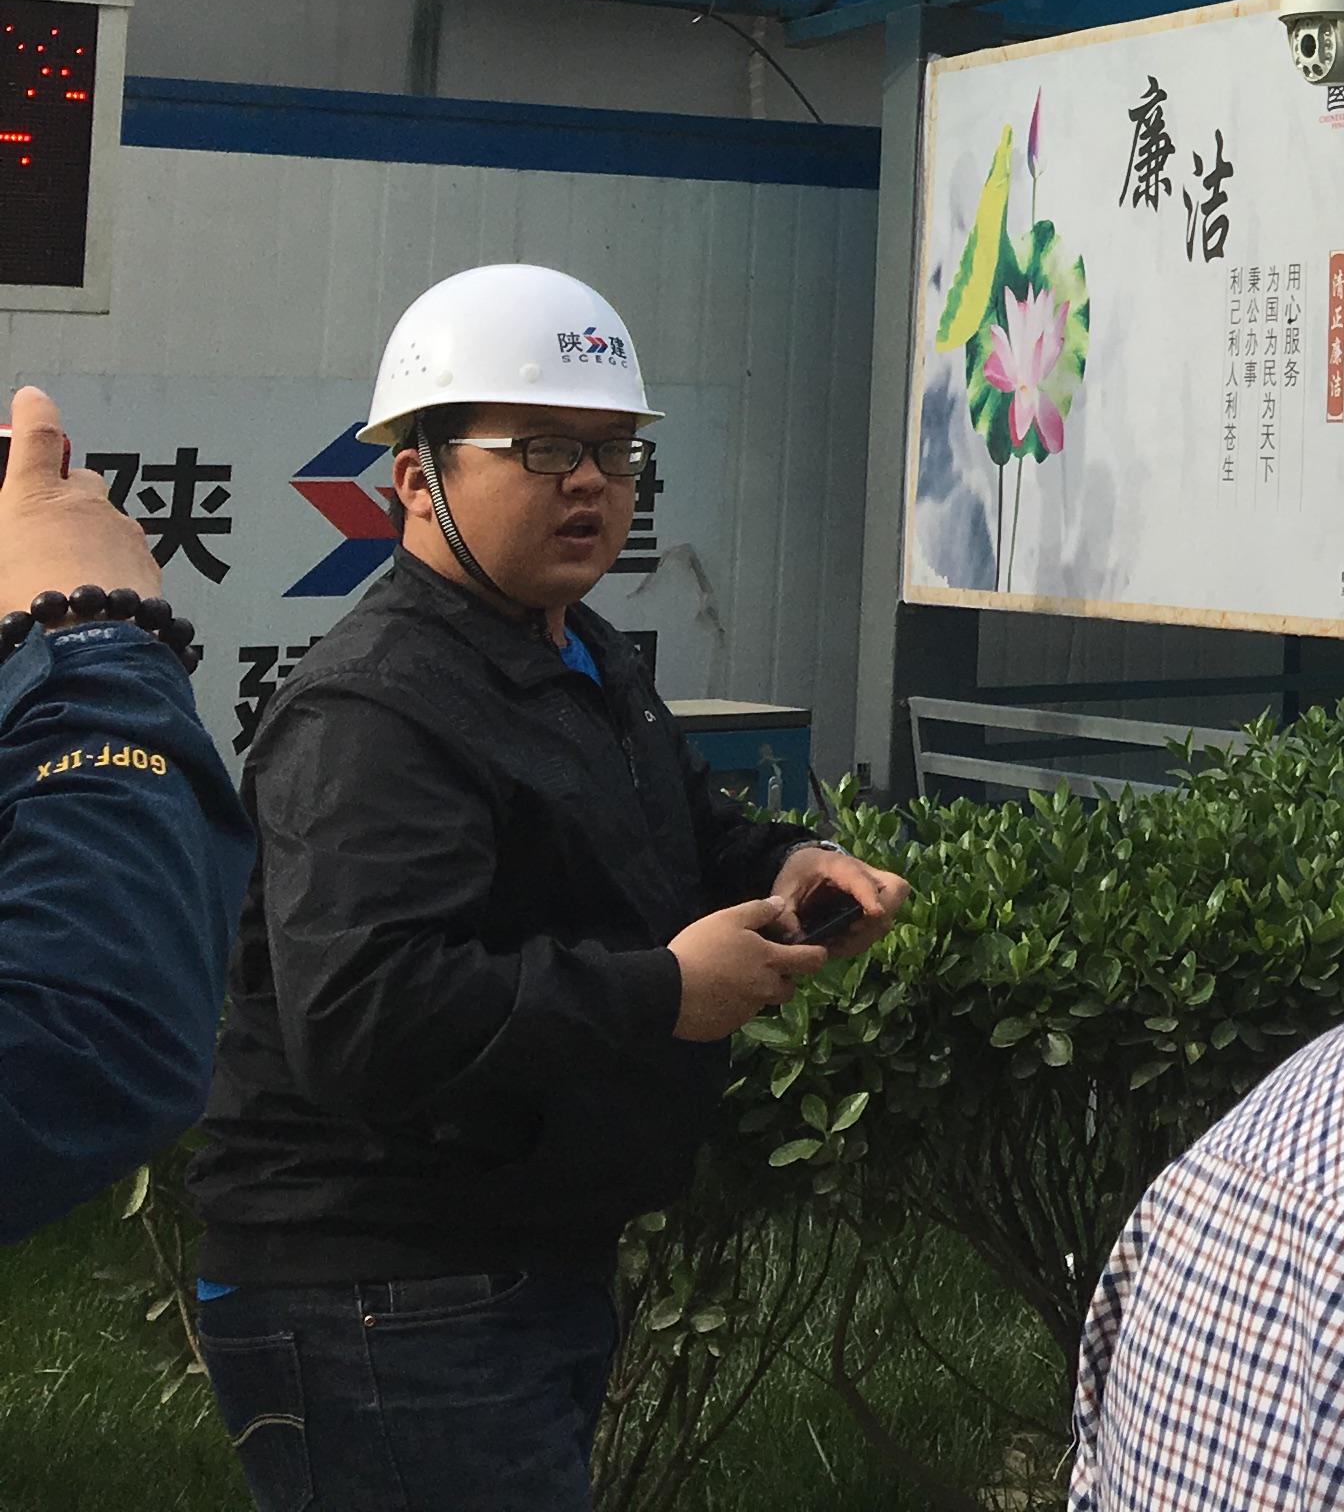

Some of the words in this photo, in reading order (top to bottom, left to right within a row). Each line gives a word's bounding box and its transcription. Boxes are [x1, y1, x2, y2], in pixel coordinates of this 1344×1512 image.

[1119, 75, 1235, 264] 廉洁
[1222, 266, 1243, 482] 利己利人利苍生
[1243, 266, 1262, 389] 秉公办事
[1260, 265, 1280, 483] 为国为民为天下
[1284, 263, 1301, 388] 用心服务
